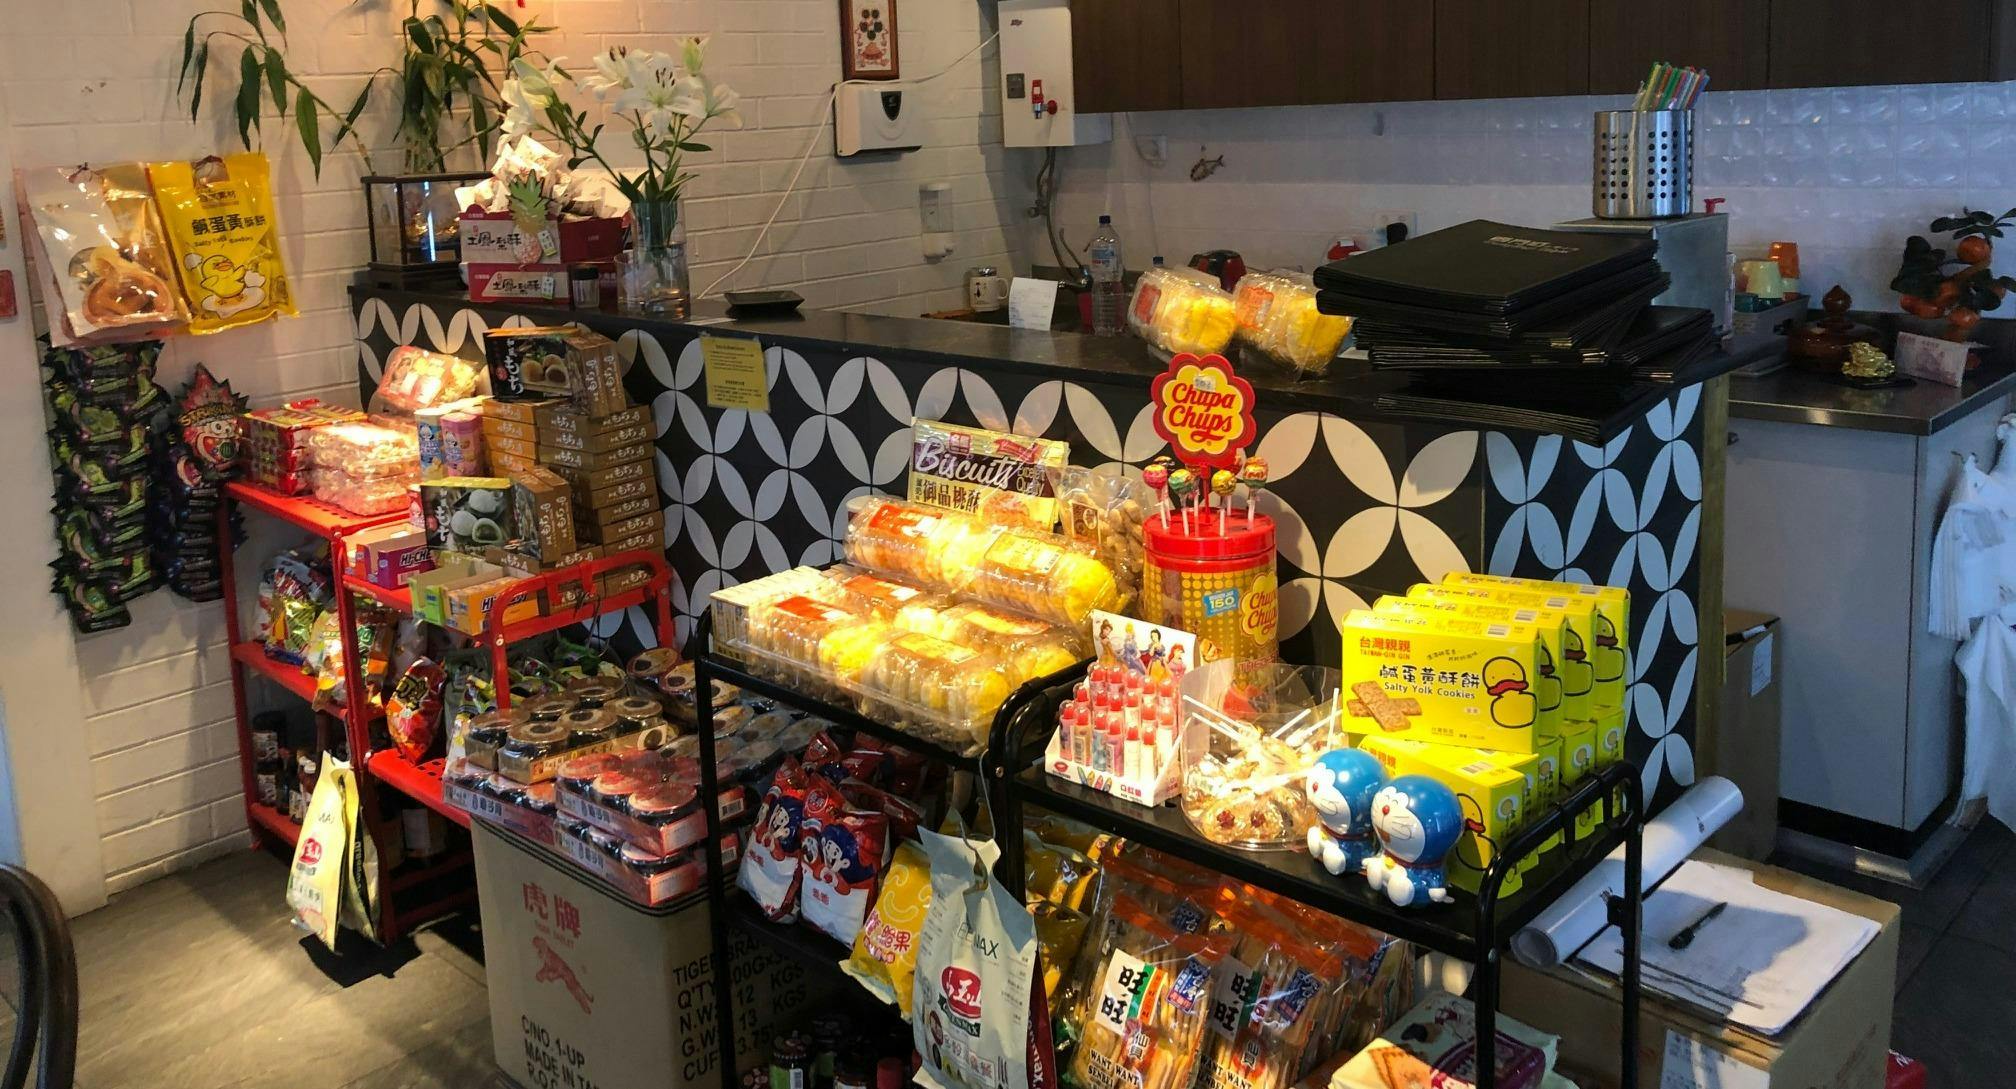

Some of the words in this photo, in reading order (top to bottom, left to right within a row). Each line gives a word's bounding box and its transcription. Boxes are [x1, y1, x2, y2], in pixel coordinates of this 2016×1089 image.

[1171, 382, 1237, 413] Chupa
[1168, 404, 1234, 443] Chups
[914, 435, 1023, 491] Biscuits
[923, 478, 980, 514] 御品桃酥
[400, 549, 432, 567] HI-CHE
[1359, 636, 1411, 653] 台灣親親
[1379, 664, 1480, 690] 鹹蛋黃酥餅
[1384, 681, 1408, 695] Salty
[1412, 684, 1433, 695] Yolk
[1437, 686, 1476, 700] Cookies
[522, 881, 582, 939] 虎牌
[737, 984, 755, 1007] 12
[1100, 965, 1149, 1025] 旺旺
[1213, 972, 1252, 1033] 旺旺
[739, 1007, 758, 1031] 13
[524, 1038, 559, 1079] MADE
[561, 1064, 574, 1087] IN
[555, 1037, 585, 1066] 1-UP
[1087, 1064, 1115, 1089] SENBEI
[1089, 1049, 1113, 1070] WANT
[1115, 1063, 1140, 1087] WANT
